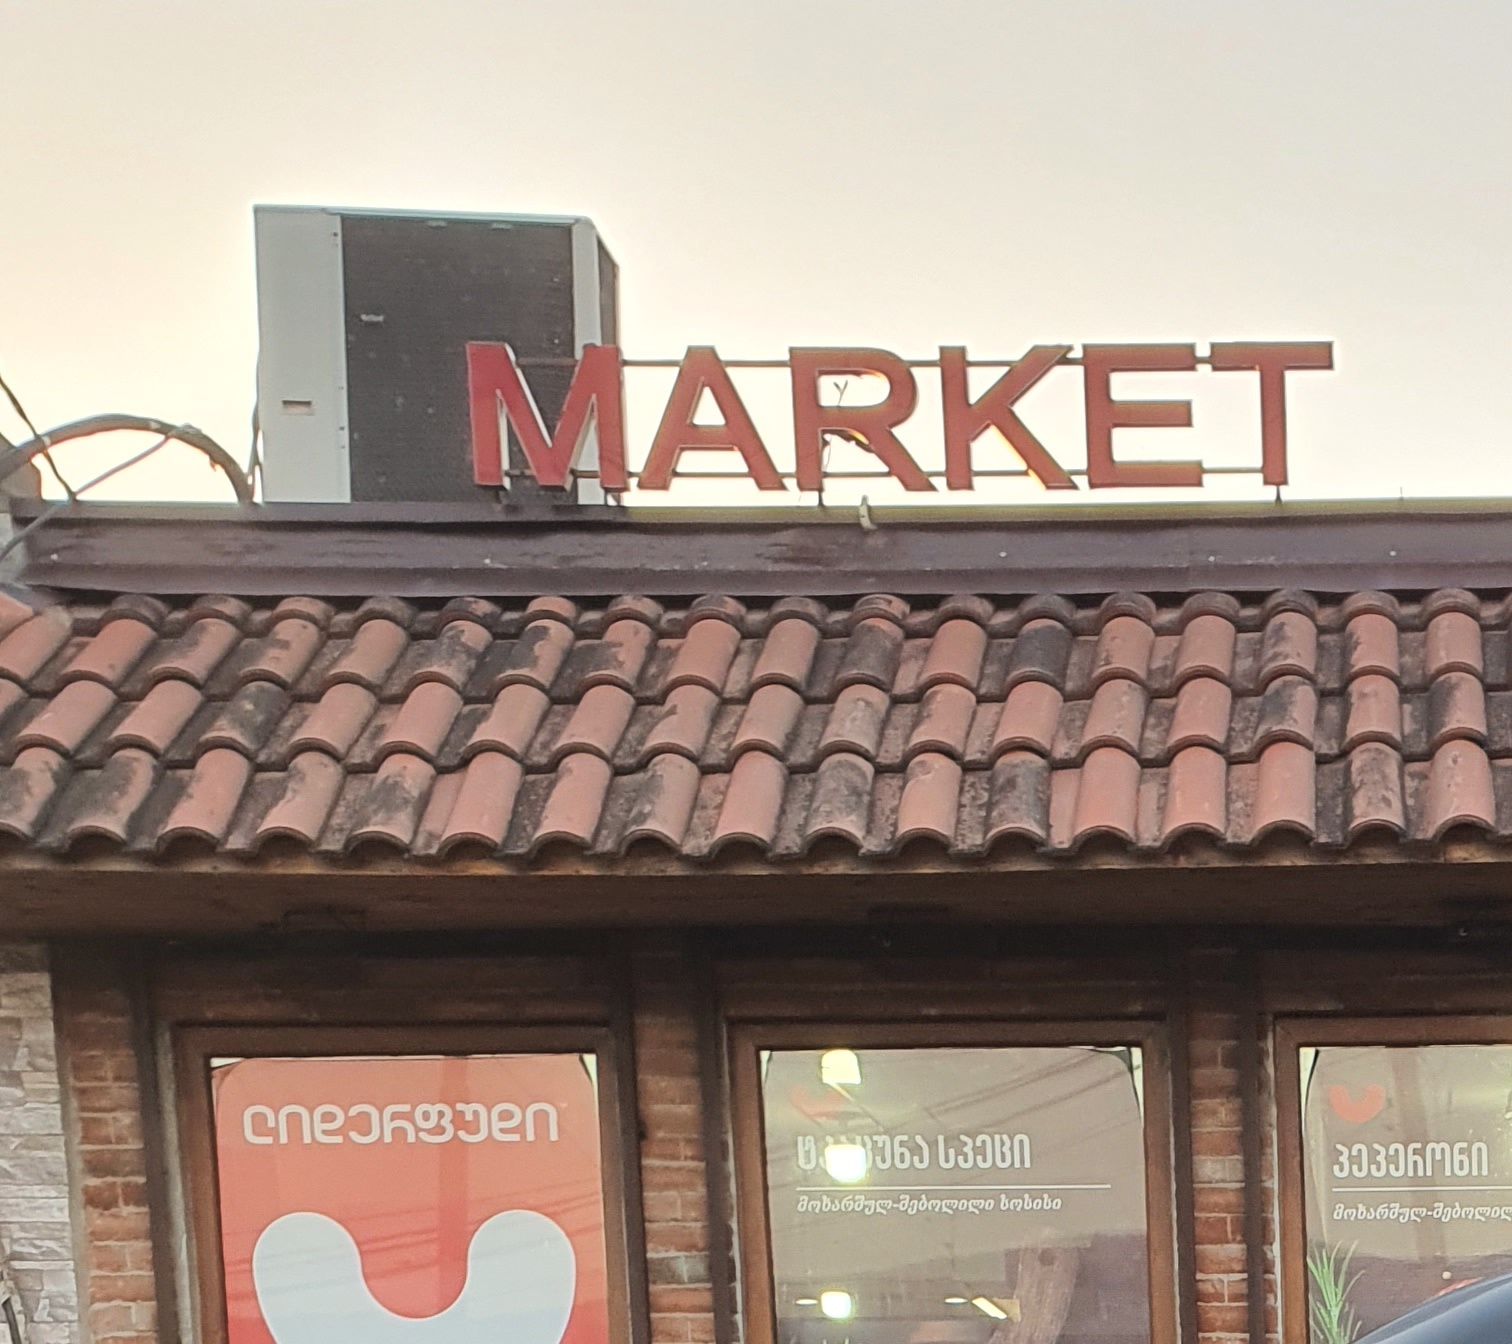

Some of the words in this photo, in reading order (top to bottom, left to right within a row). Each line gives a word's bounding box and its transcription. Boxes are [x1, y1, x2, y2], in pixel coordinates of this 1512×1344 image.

[466, 341, 1334, 491] MARKET
[938, 1133, 1032, 1169] სპეცი
[1332, 1141, 1489, 1178] პეპერონი
